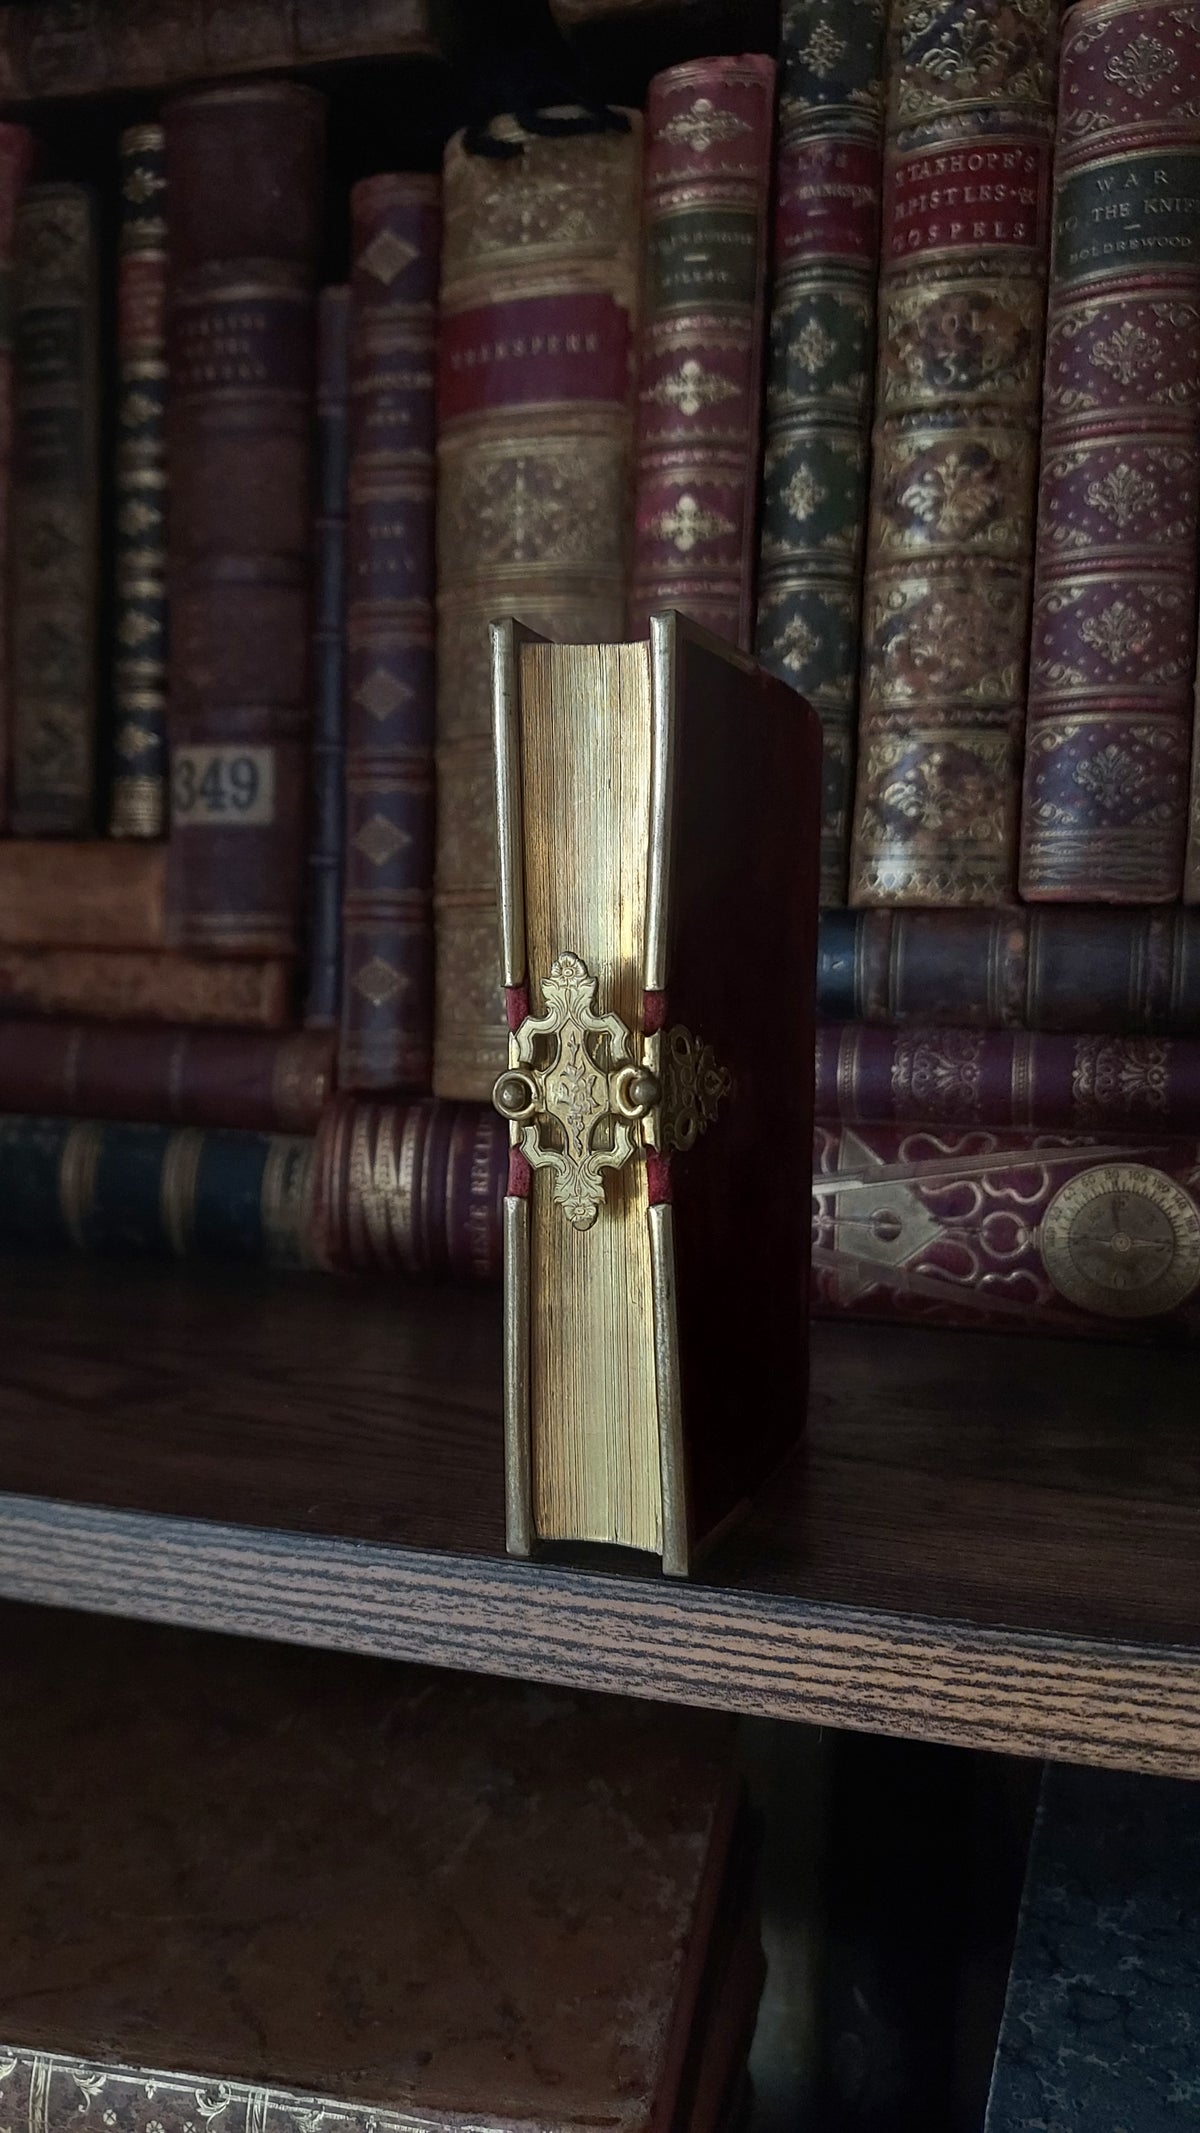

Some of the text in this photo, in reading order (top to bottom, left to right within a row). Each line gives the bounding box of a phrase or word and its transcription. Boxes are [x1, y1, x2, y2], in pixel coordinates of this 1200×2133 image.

[894, 149, 1035, 188] STANHOPE'S
[1095, 169, 1169, 194] WAR
[1091, 203, 1131, 223] THE
[892, 222, 1026, 252] GOSPELS
[173, 758, 260, 812] 349
[1104, 1169, 1120, 1181] 80
[1128, 1170, 1148, 1183] 100
